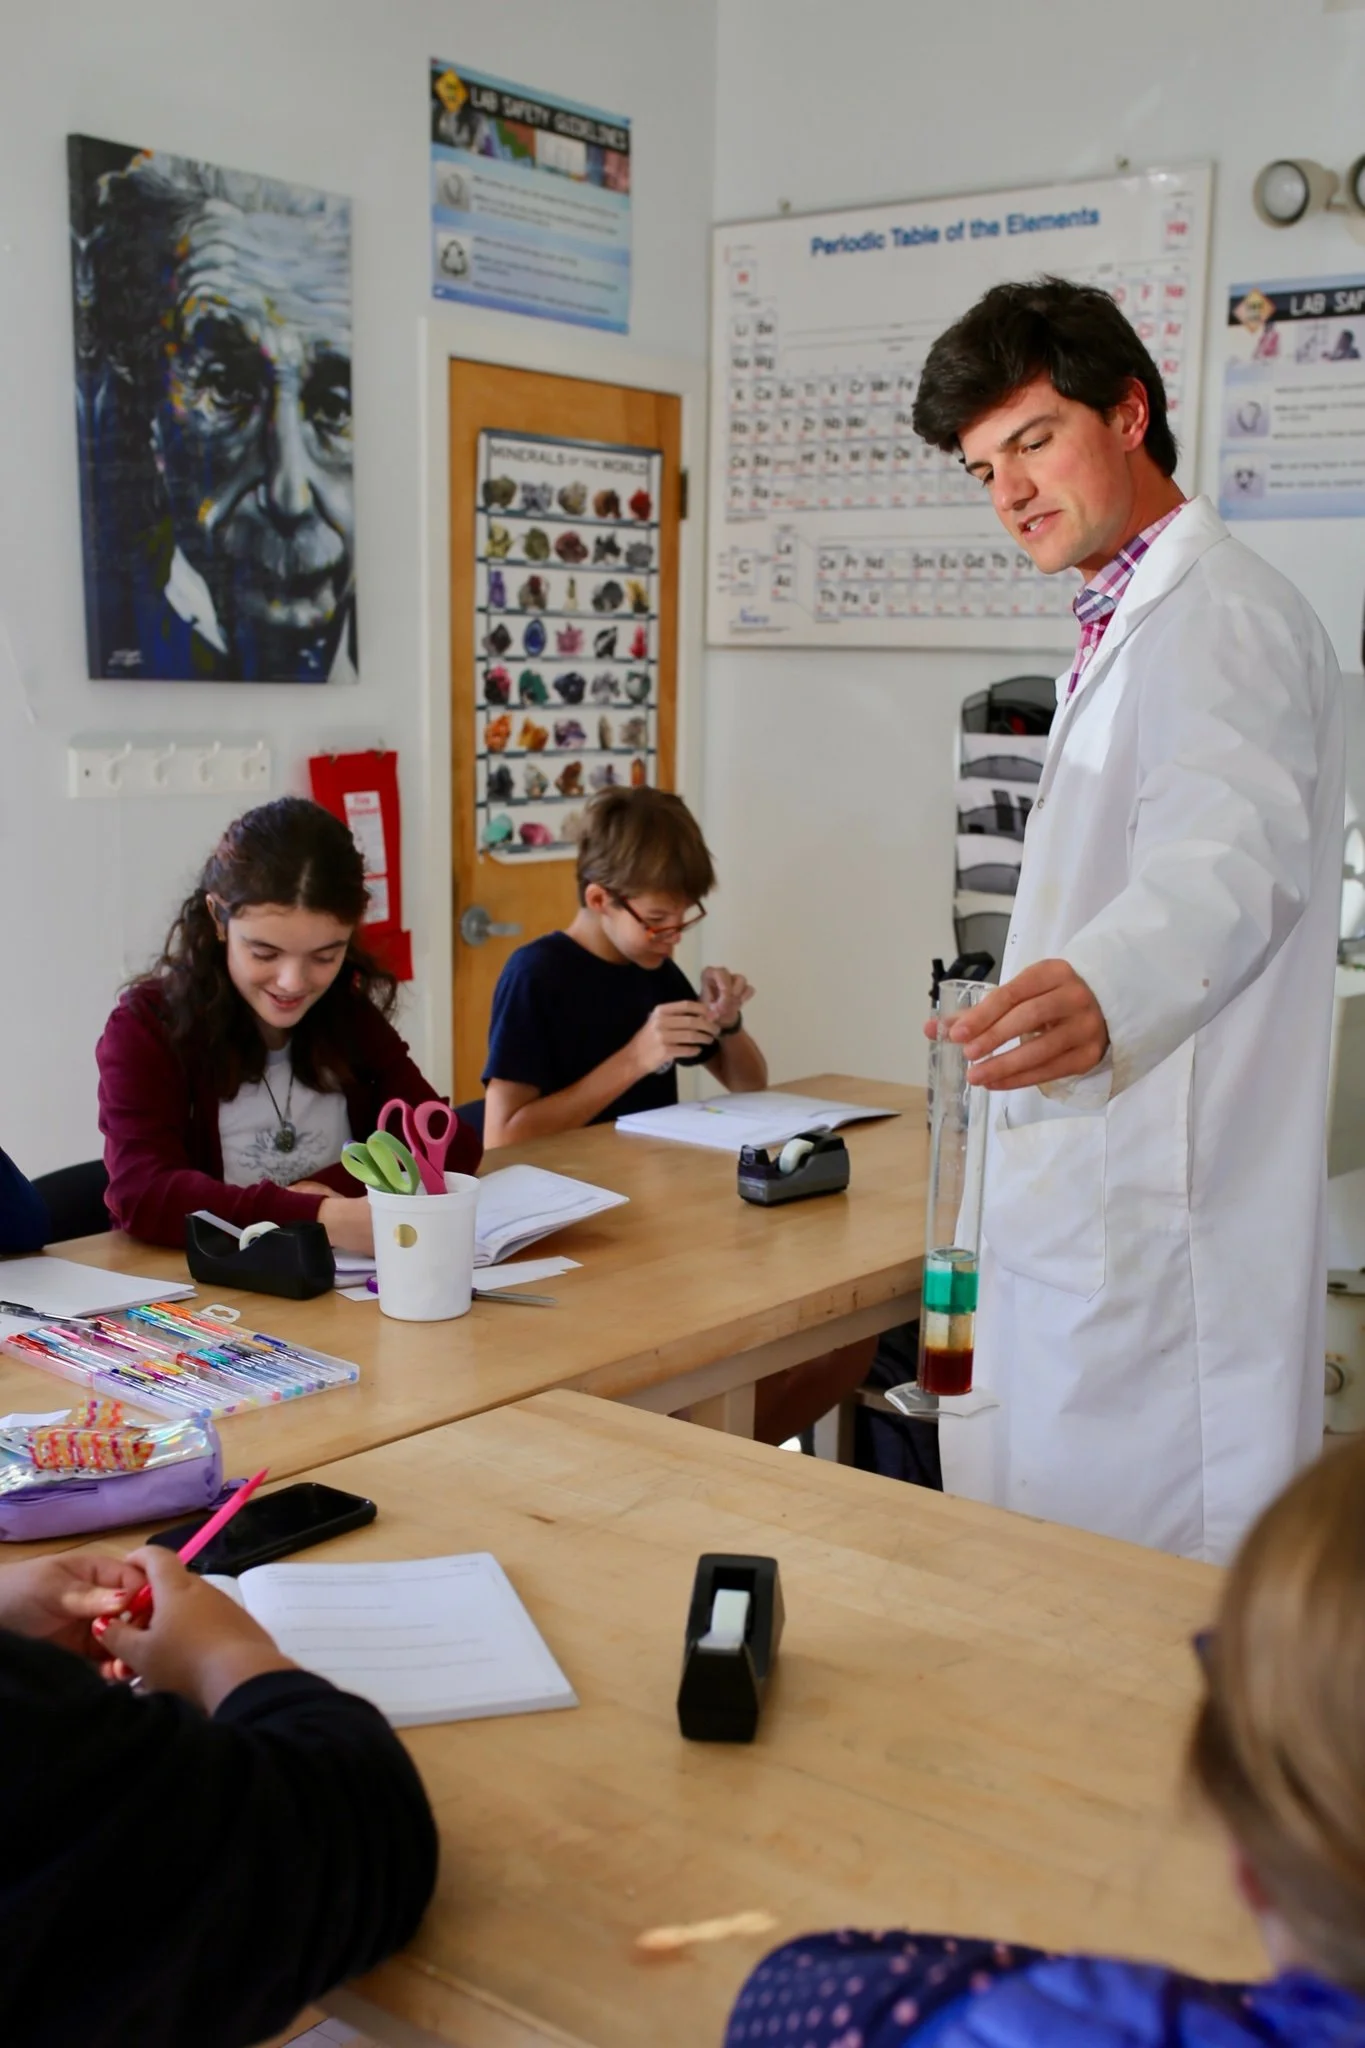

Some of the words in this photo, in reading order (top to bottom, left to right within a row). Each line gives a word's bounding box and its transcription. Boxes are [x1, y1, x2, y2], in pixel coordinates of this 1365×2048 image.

[470, 86, 498, 113] LAB
[501, 96, 550, 126] SAFETY
[554, 113, 628, 151] GUIDELINES
[811, 230, 885, 256] Periodic
[890, 223, 940, 247] Table
[945, 219, 964, 241] of
[970, 216, 1000, 237] the
[1005, 207, 1099, 235] Elements
[1289, 293, 1326, 316] LAB
[1333, 288, 1365, 313] SAF
[489, 445, 565, 467] MINERALS
[602, 459, 648, 475] WORLD
[738, 558, 750, 574] C
[912, 553, 936, 569] Sm
